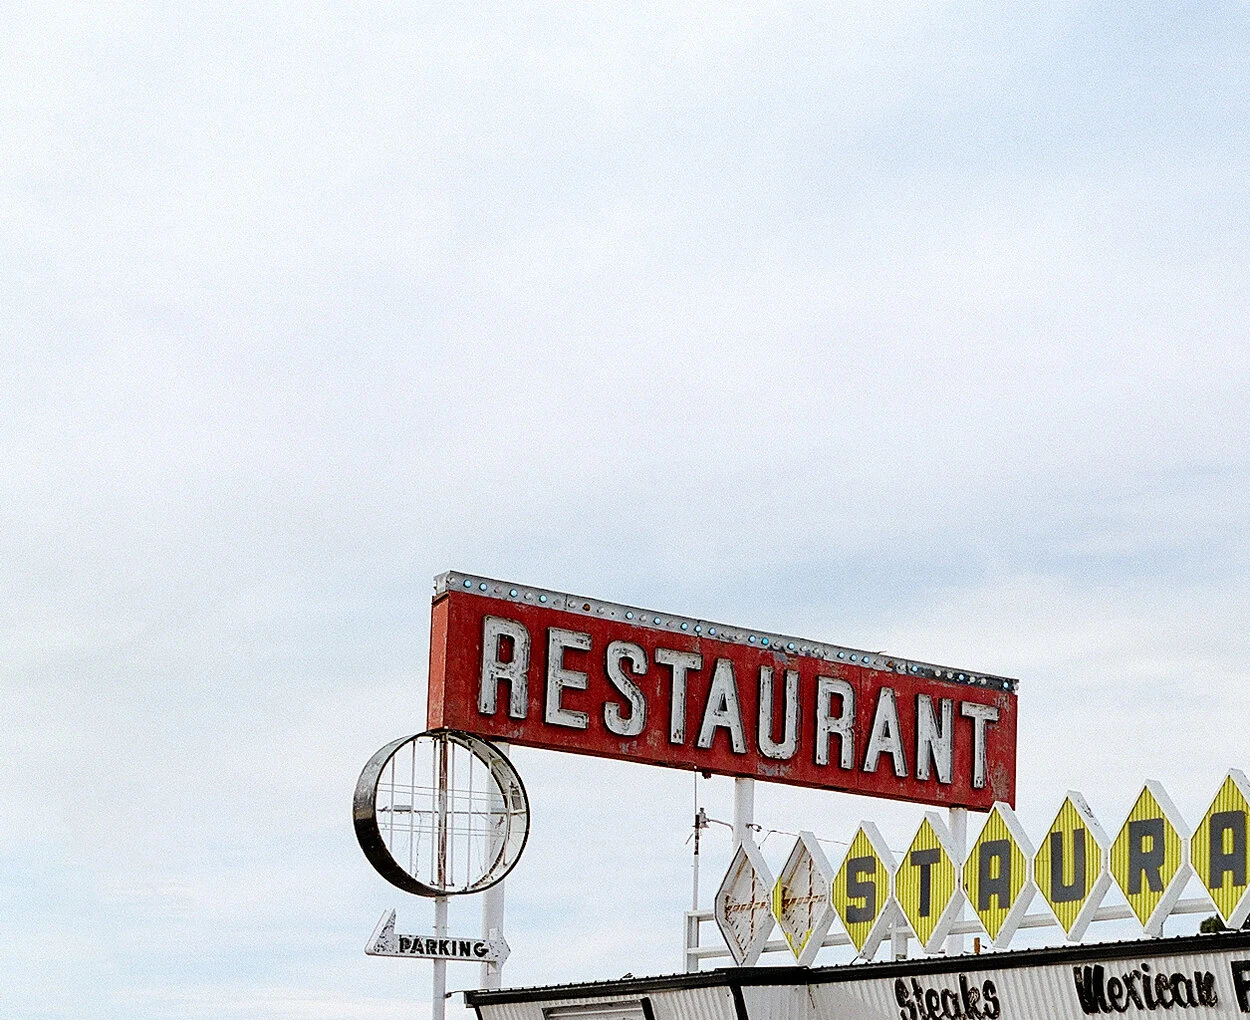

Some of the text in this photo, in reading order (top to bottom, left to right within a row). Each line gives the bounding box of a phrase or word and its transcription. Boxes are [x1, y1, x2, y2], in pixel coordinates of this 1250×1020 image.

[477, 614, 1000, 789] RESTAURANT
[398, 936, 490, 957] PARKING
[1072, 962, 1219, 1015] Mexican
